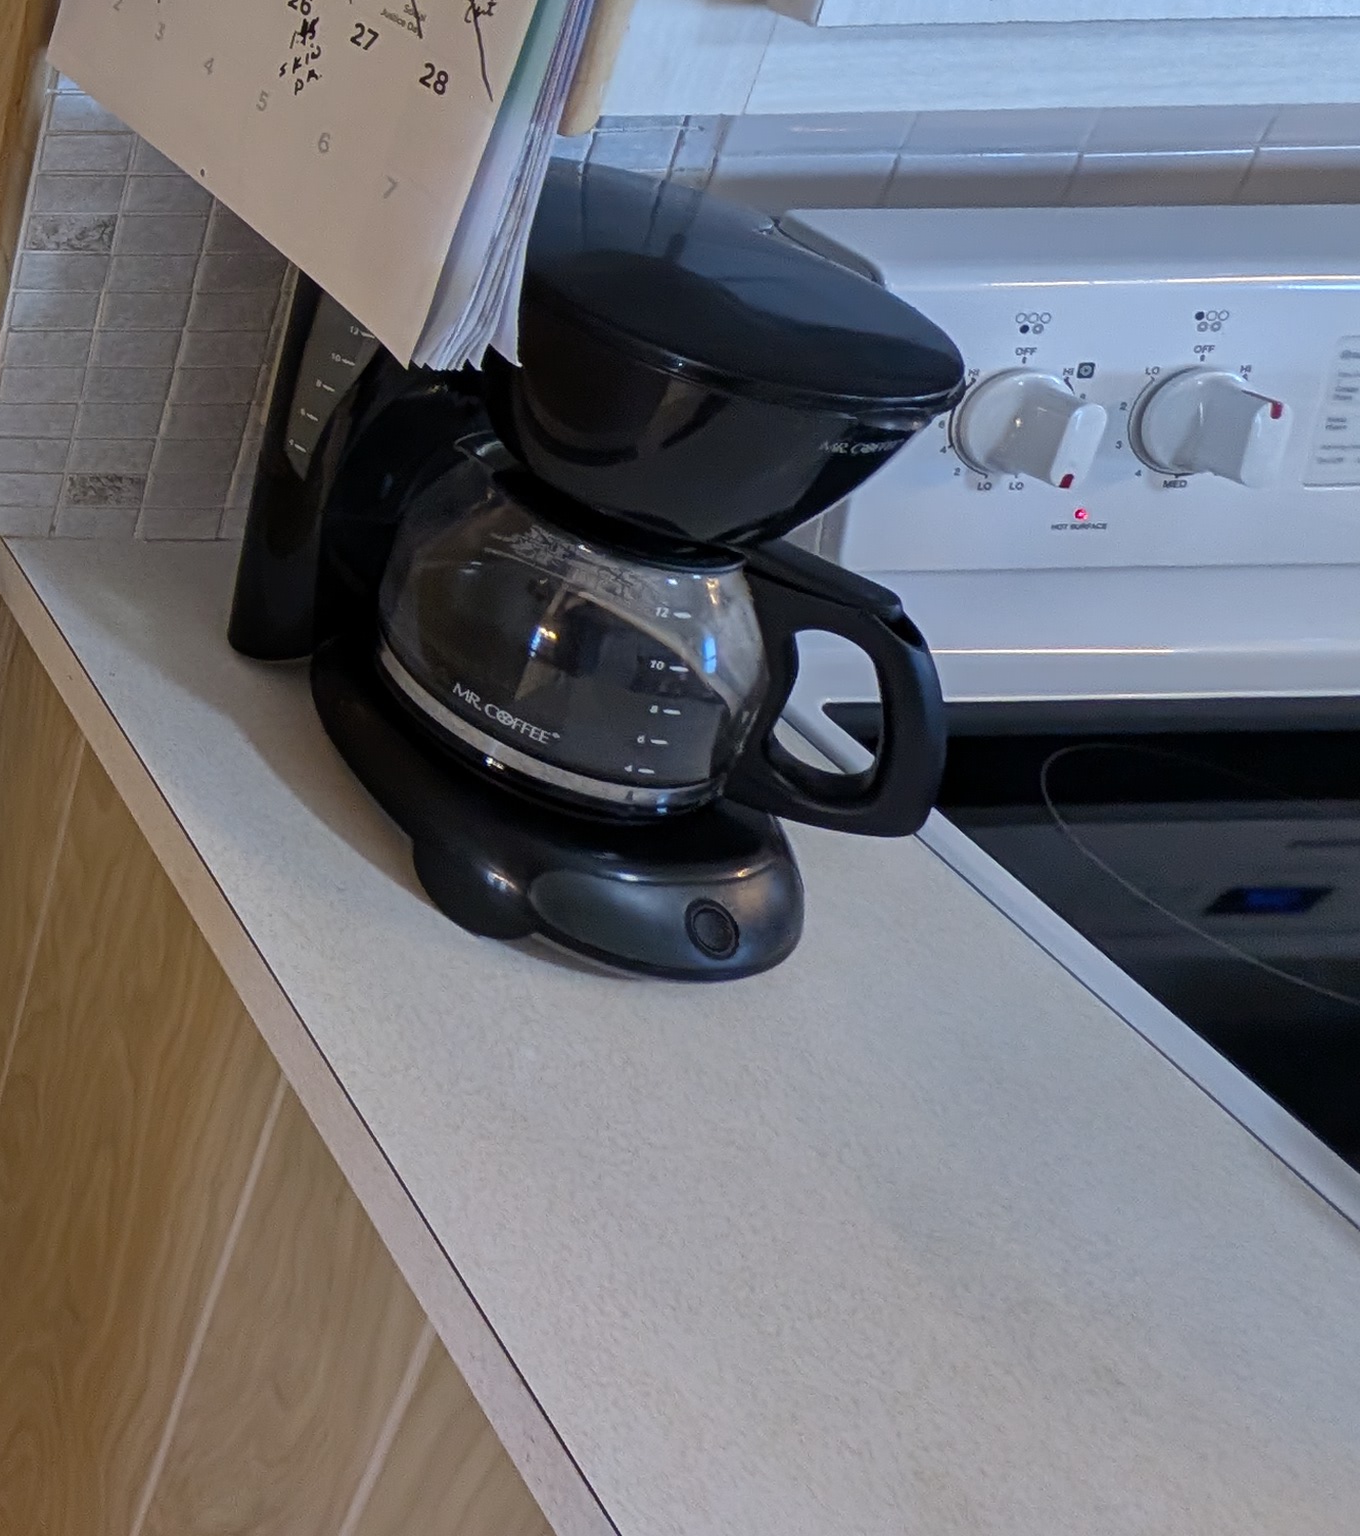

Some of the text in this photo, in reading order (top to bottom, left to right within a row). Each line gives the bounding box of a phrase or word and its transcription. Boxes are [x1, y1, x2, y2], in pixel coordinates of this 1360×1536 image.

[350, 22, 379, 50] 27
[419, 63, 449, 95] 28
[155, 22, 166, 41] 3
[204, 57, 214, 75] 4
[256, 91, 269, 112] 5
[318, 132, 330, 154] 6
[384, 176, 398, 199] 7
[1014, 347, 1038, 357] OFF
[1192, 344, 1215, 355] OFF
[968, 367, 1075, 378] HI HI
[1144, 364, 1252, 376] LO HI
[977, 481, 1025, 492] LO LO
[1162, 479, 1188, 489] MED
[1051, 522, 1108, 531] HOT SURFACE
[655, 606, 670, 619] 12
[650, 659, 665, 671] 10
[650, 704, 659, 714] 8
[484, 703, 552, 744] COFFEE
